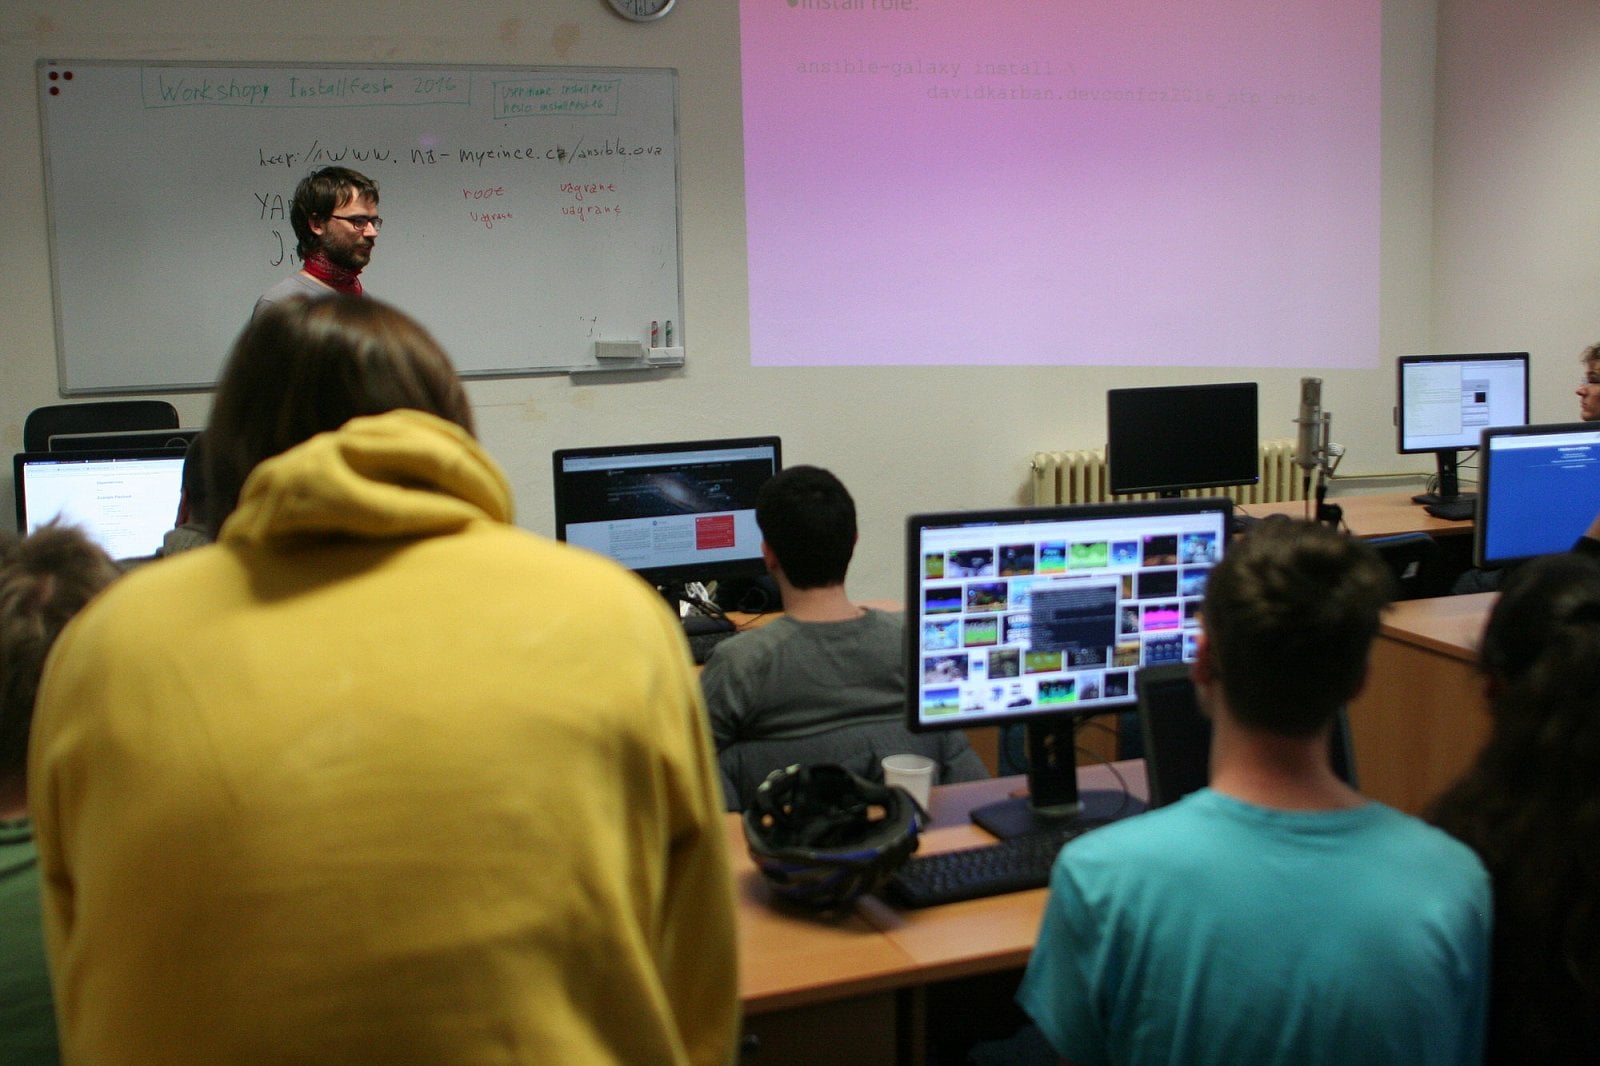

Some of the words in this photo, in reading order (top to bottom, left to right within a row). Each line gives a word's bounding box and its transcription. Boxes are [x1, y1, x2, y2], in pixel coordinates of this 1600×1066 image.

[796, 57, 962, 78] ansible-galaxy
[462, 185, 505, 200] root
[560, 182, 617, 201] vagrant
[254, 192, 294, 220] YA
